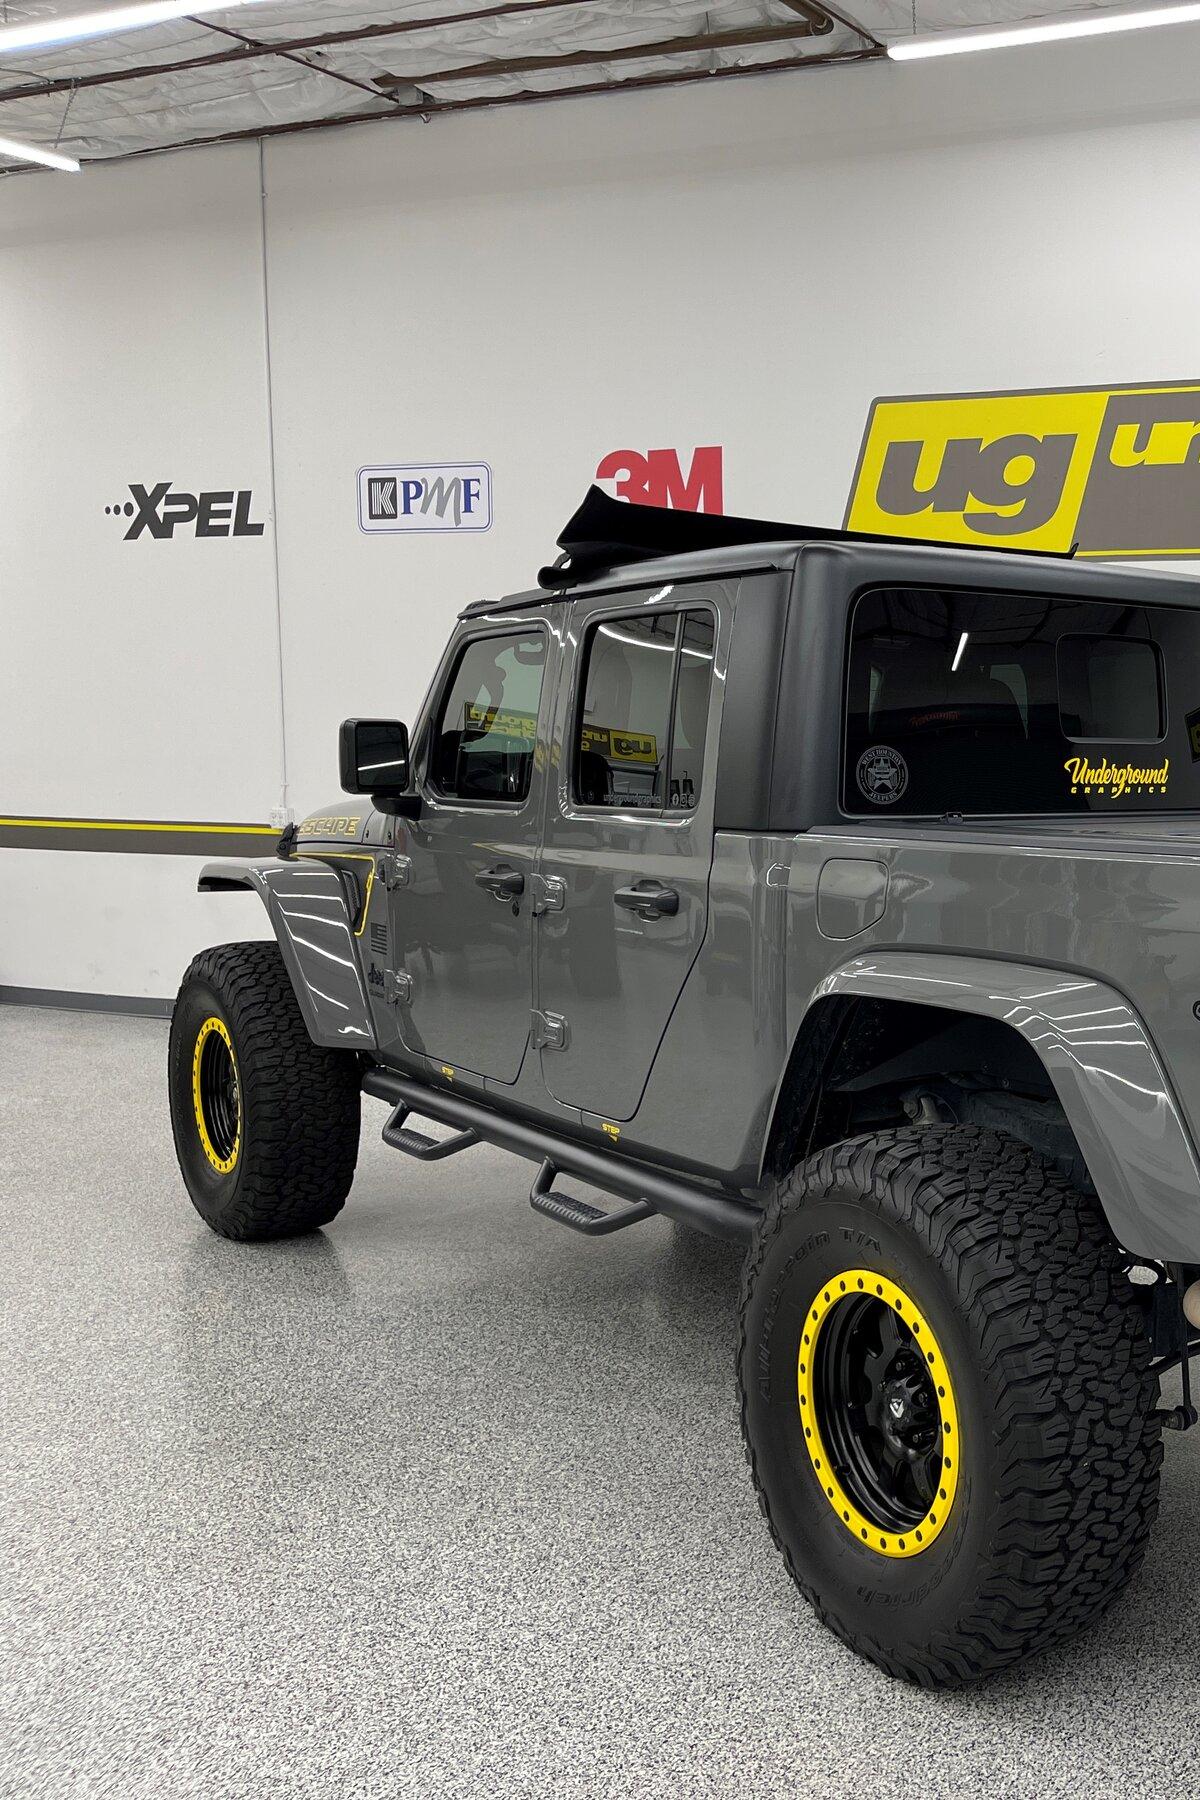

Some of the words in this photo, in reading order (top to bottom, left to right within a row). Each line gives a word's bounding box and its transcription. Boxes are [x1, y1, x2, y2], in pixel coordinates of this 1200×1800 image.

[596, 446, 722, 515] 3M
[878, 436, 1074, 534] ug
[123, 482, 265, 541] XPEL
[1064, 757, 1169, 799] Underground
[1071, 786, 1167, 794] GRAPHICS
[441, 1066, 455, 1077] STEP
[602, 1124, 621, 1135] STEP
